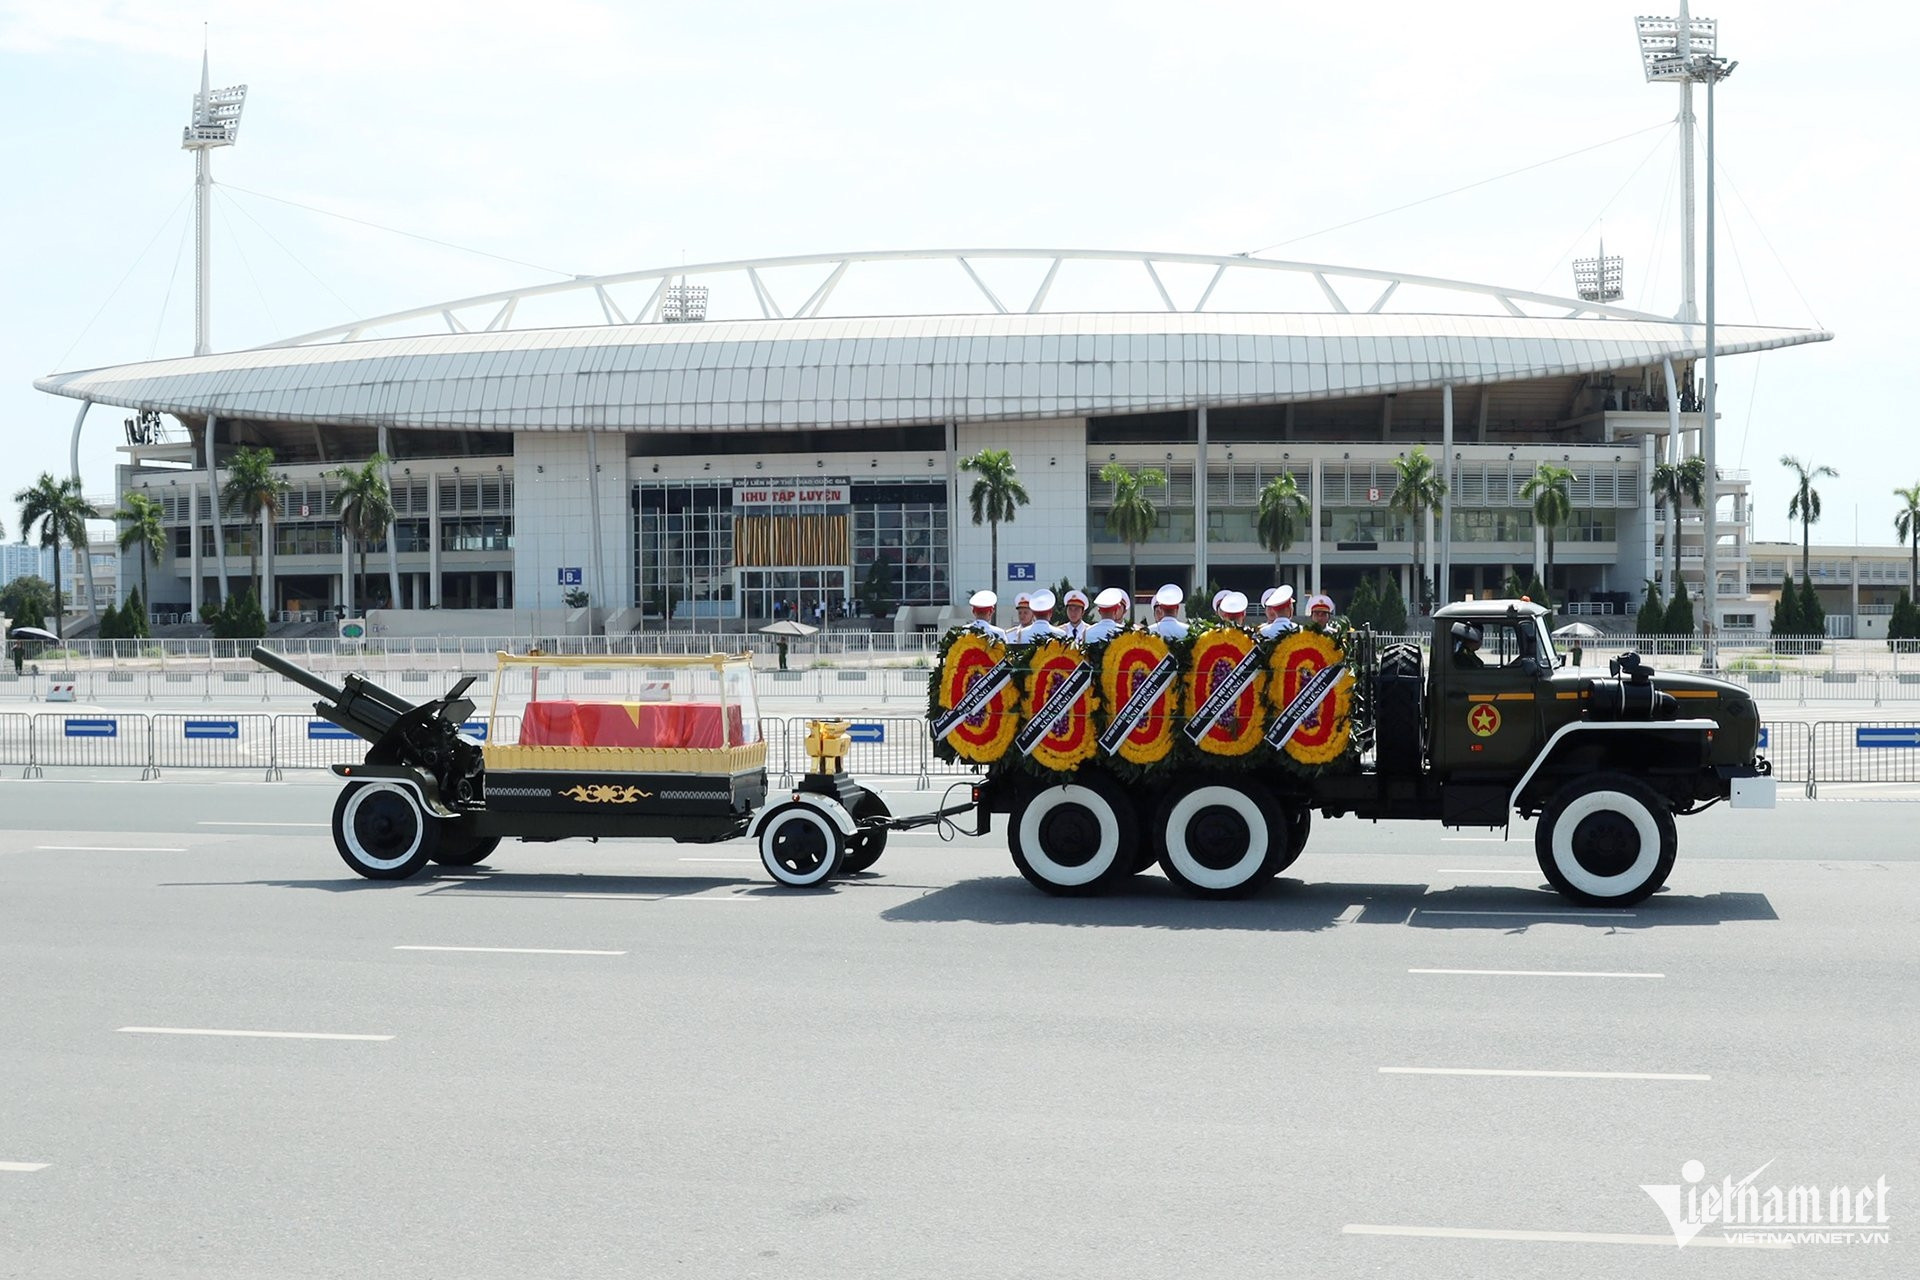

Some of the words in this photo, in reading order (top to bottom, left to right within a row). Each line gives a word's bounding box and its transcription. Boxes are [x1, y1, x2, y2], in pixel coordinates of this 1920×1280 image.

[741, 492, 767, 502] KHU
[771, 489, 796, 504] TẬP
[1370, 489, 1379, 500] B
[302, 505, 309, 516] B
[566, 572, 574, 583] B
[1017, 567, 1026, 578] B
[967, 686, 989, 707] VIẾNG
[1209, 697, 1226, 715] KÍNH
[1222, 677, 1243, 700] VIẾNG
[1291, 703, 1307, 720] KÍNH
[1303, 683, 1325, 705] VIẾNG
[1124, 706, 1140, 724] KÍNH
[1136, 685, 1156, 708] VIẾNG
